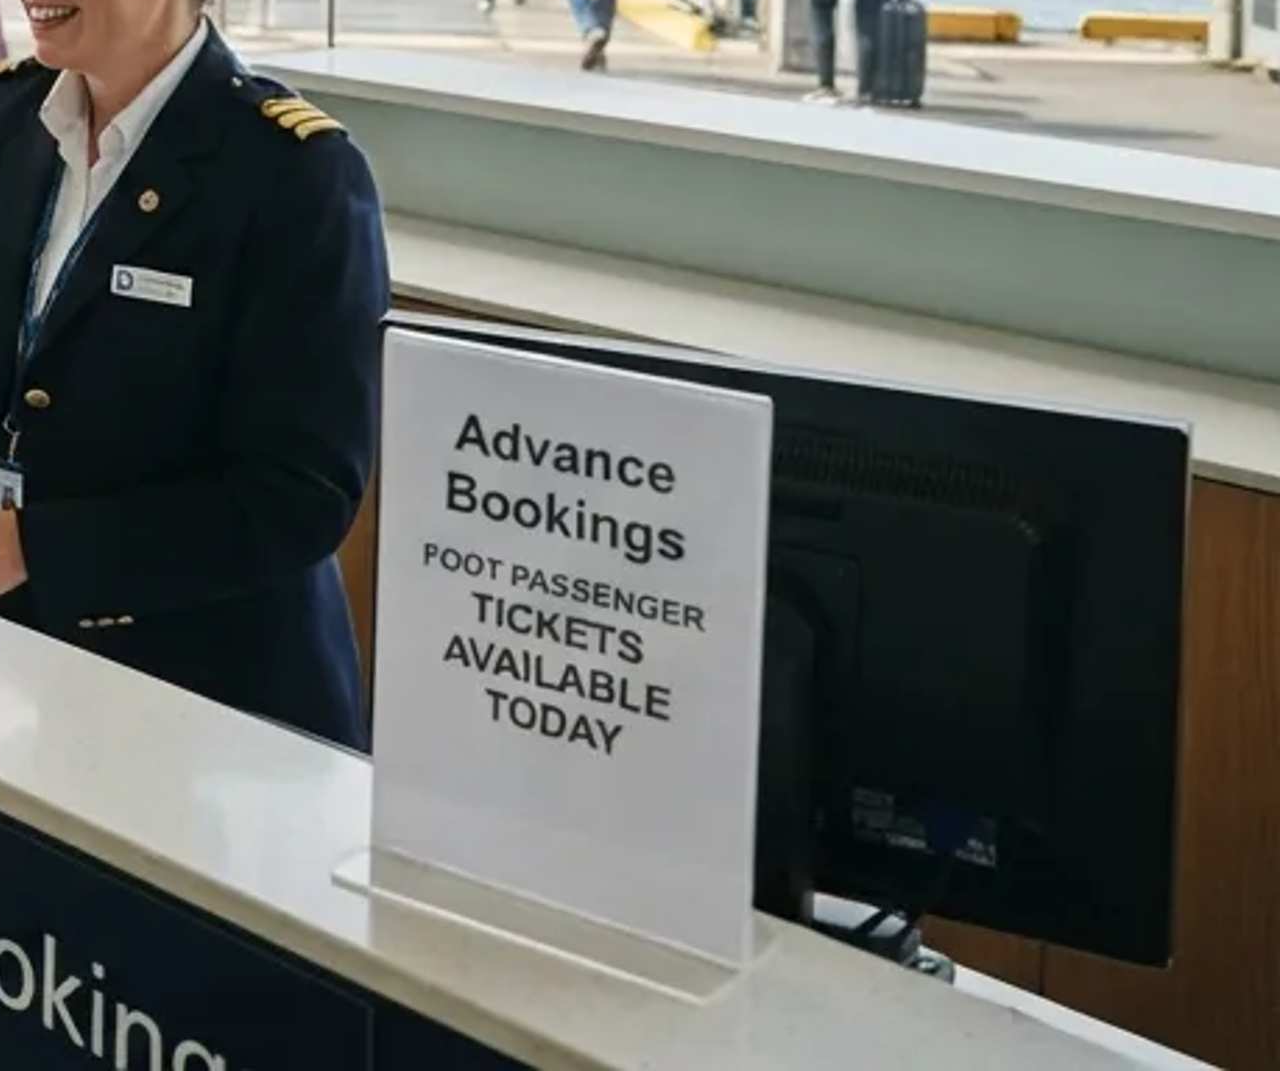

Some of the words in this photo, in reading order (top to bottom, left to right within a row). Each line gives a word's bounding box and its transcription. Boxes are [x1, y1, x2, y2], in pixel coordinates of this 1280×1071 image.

[454, 412, 677, 495] Advance
[446, 469, 686, 565] Bookings
[471, 591, 644, 665] TICKETS
[511, 563, 706, 631] PASSENGER
[443, 634, 672, 721] AVAILABLE
[485, 688, 623, 757] TODAY
